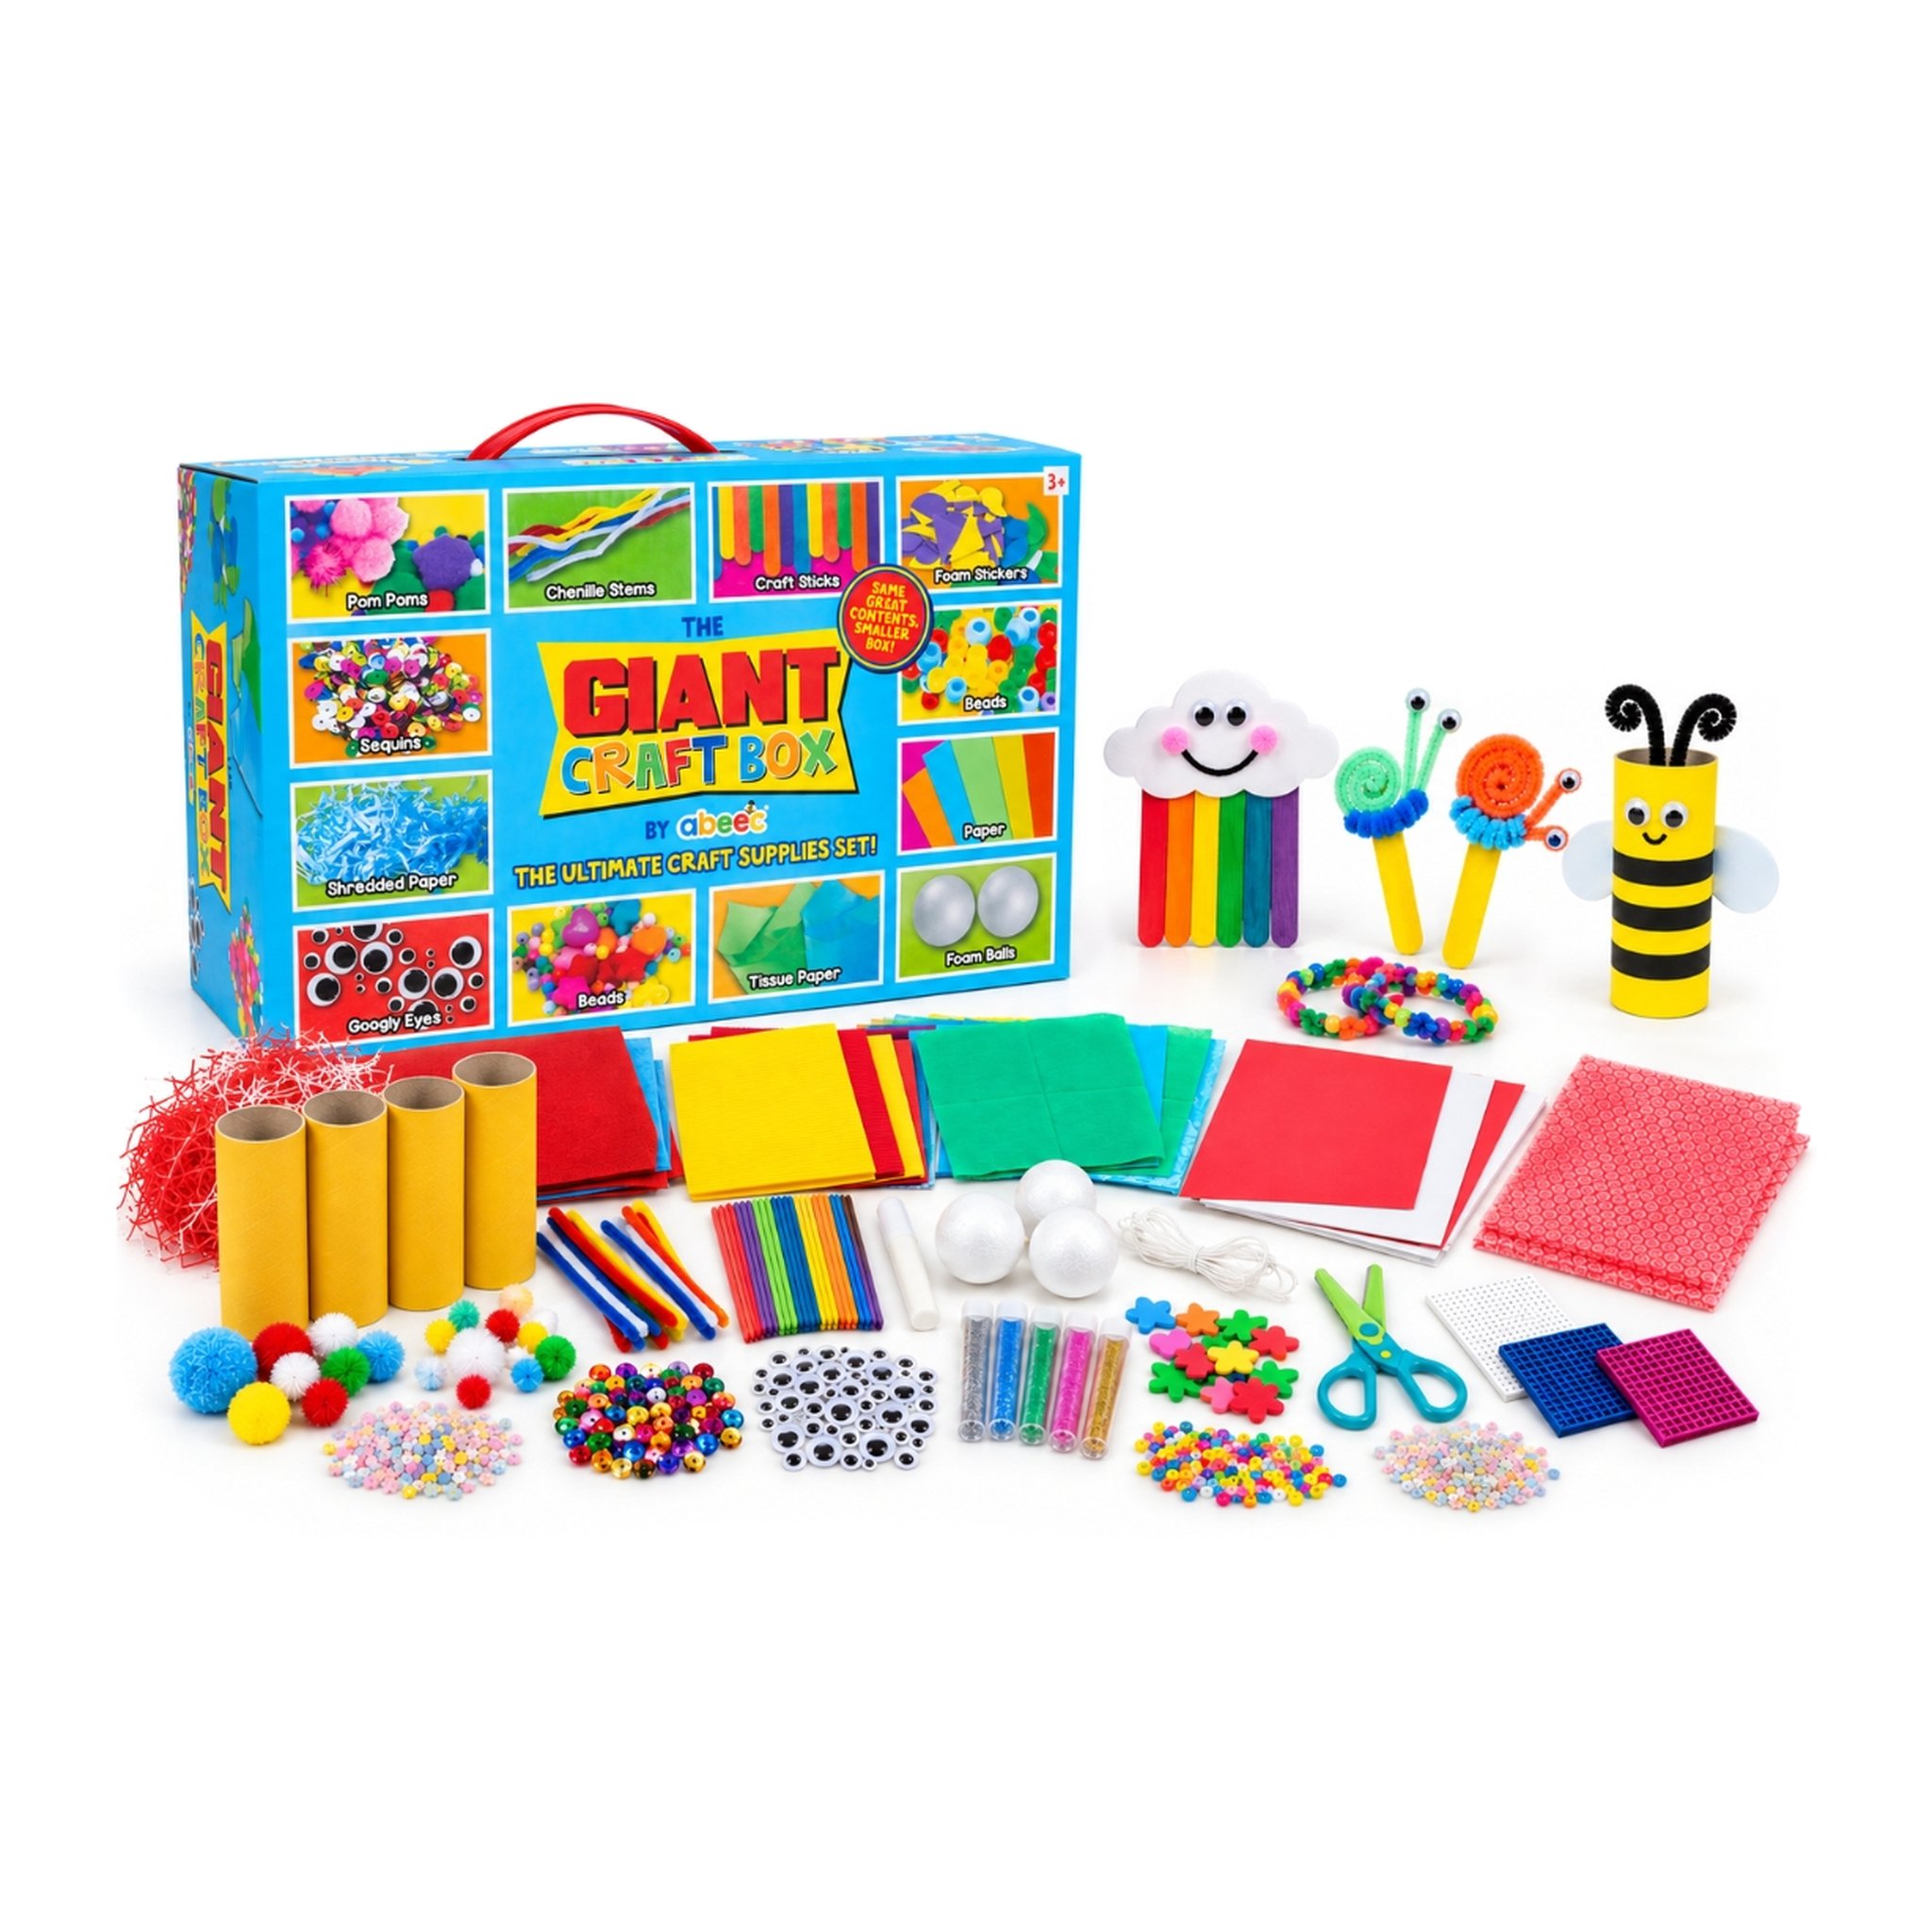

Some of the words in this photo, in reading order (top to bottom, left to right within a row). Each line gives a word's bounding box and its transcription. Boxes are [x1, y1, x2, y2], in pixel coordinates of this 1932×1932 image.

[1048, 473, 1065, 491] 3+
[755, 575, 794, 591] Craft
[798, 574, 841, 589] Sticks
[934, 569, 972, 583] Foam
[974, 567, 1028, 581] Stickers
[545, 583, 606, 600] Chenille
[608, 581, 656, 597] Stems
[872, 581, 907, 598] SAME
[346, 593, 383, 609] Pom
[385, 591, 429, 608] Poms
[866, 594, 908, 611] GREAT
[681, 615, 724, 638] THE
[849, 607, 919, 628] CONTENTS,
[854, 622, 909, 640] SMALLER
[865, 637, 895, 653] BOX!
[563, 646, 841, 739] GIANT
[194, 633, 208, 780] CRAFT
[964, 694, 1008, 711] Beads
[359, 736, 422, 755] Sequins
[206, 639, 226, 893] GIANT
[560, 734, 729, 795] CRAFT
[740, 728, 838, 783] BOX
[644, 820, 670, 840] BY
[678, 809, 767, 839] abeec
[964, 824, 1006, 841] Paper
[514, 865, 557, 888] THE
[561, 855, 663, 883] ULTIMATE
[667, 848, 733, 874] CRAFT
[738, 839, 829, 867] SUPPLIES
[834, 835, 876, 858] SET!
[327, 875, 405, 896] Shredded
[408, 874, 458, 891] Paper
[946, 952, 982, 966] Foam
[986, 945, 1016, 961] Balls
[748, 973, 794, 989] Tissue
[797, 968, 841, 985] Paper
[577, 990, 625, 1008] Beads
[348, 1015, 401, 1034] Googly
[404, 1012, 442, 1030] Eyes
